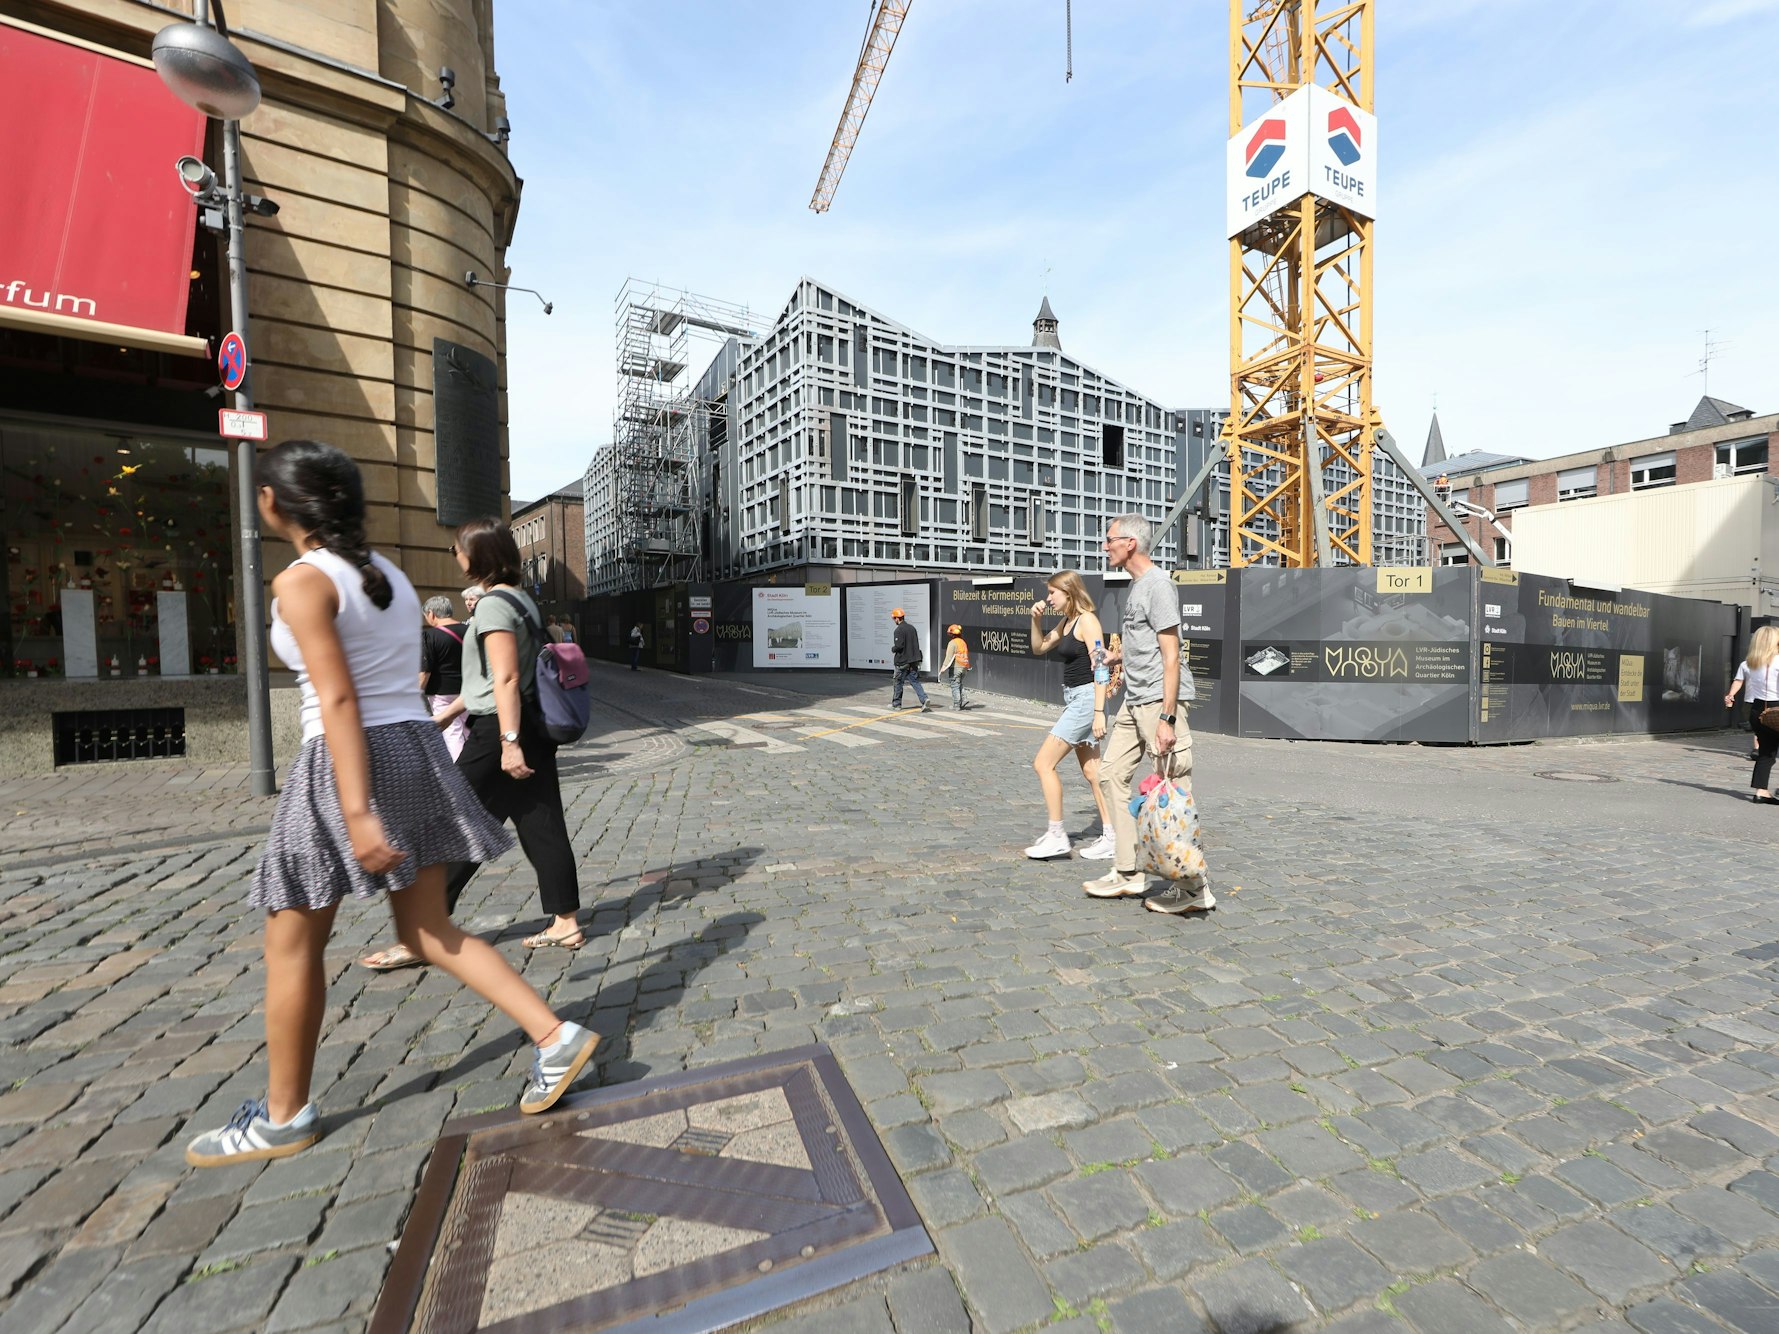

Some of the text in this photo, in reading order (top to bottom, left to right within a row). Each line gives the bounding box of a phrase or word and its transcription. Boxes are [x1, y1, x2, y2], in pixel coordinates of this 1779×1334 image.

[1324, 166, 1364, 196] TEUPE
[1242, 170, 1290, 212] TEUPE
[1386, 574, 1423, 588] Tor 1
[953, 588, 1034, 603] Blütezeit & Formenspiel
[1538, 589, 1650, 618] Fundamental und wandelbar
[982, 604, 1014, 617] Vielfältiges
[1552, 614, 1609, 631] Bauen im Viertel
